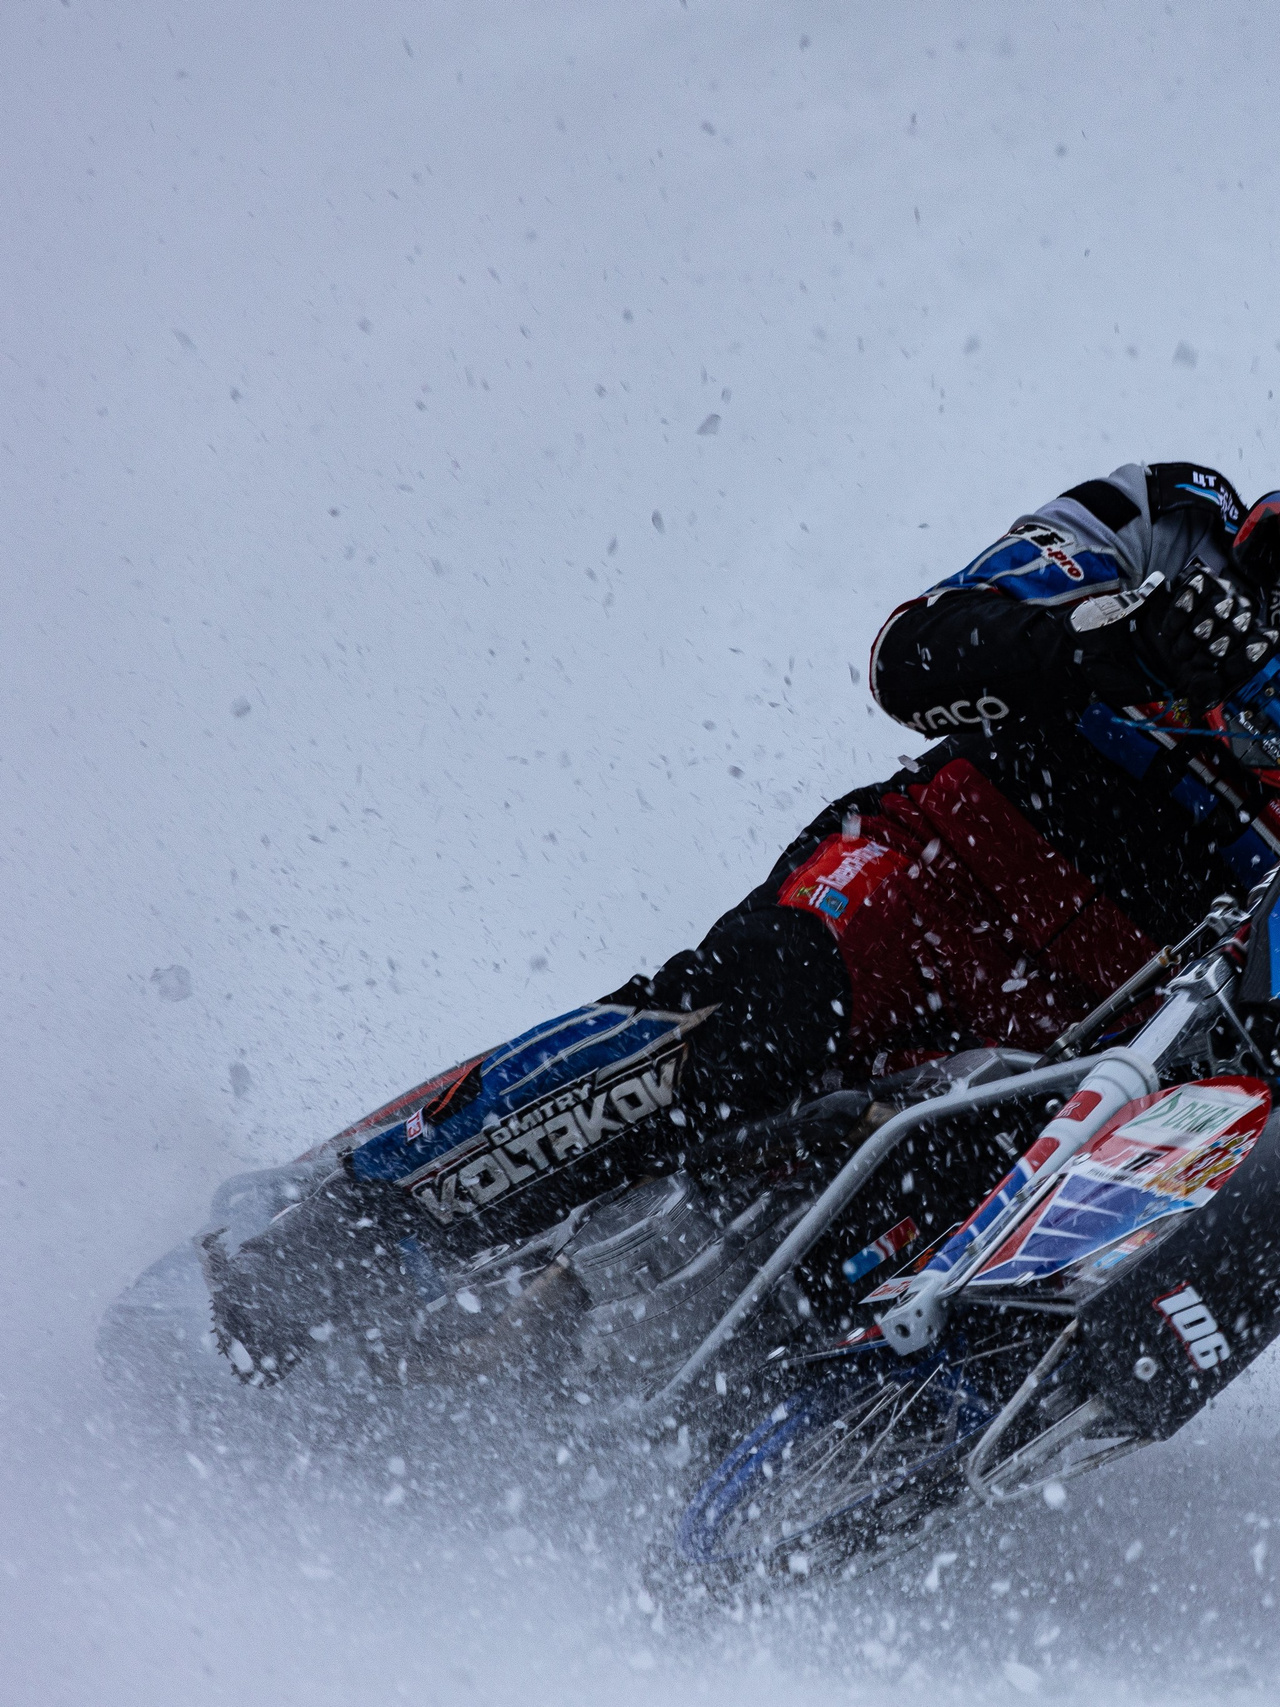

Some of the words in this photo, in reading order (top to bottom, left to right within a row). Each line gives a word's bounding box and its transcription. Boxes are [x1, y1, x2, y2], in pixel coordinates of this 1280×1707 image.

[412, 1057, 680, 1225] KOLTAKOV
[490, 1085, 593, 1144] DMITRY
[1158, 1100, 1240, 1135] DEKRA
[1157, 1284, 1231, 1370] 106
